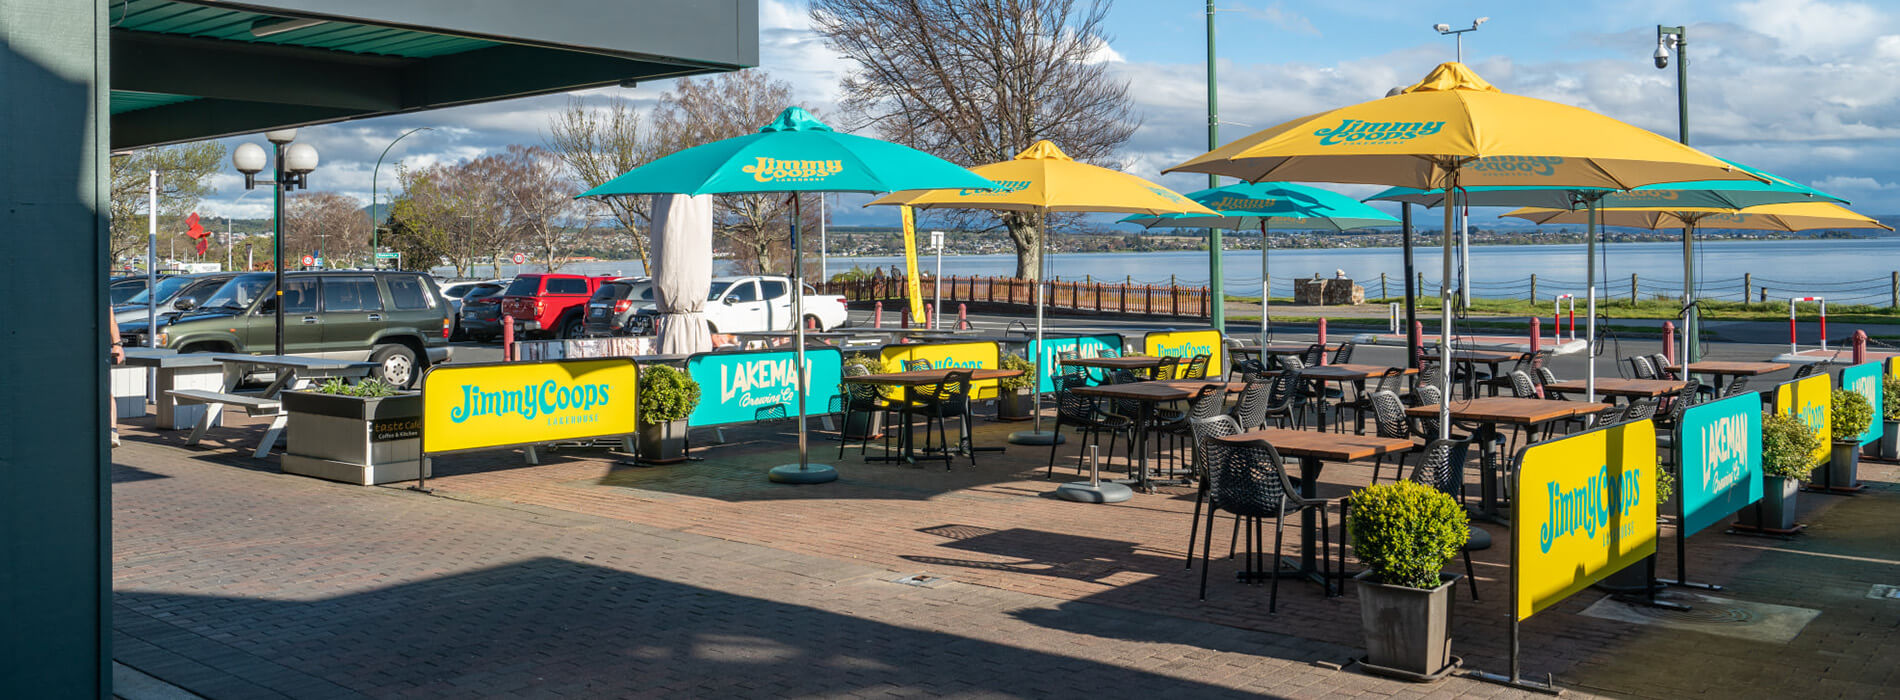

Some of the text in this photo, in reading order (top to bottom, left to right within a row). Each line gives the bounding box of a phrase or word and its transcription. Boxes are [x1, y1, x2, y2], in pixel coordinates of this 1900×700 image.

[1313, 119, 1446, 136] Jimmy
[1319, 131, 1417, 146] Coops
[742, 157, 843, 173] Jimmy
[754, 167, 830, 183] Coops
[375, 421, 404, 432] taste
[547, 413, 599, 426] LAKEHOUSE
[1701, 412, 1748, 492] LAKEMAN
